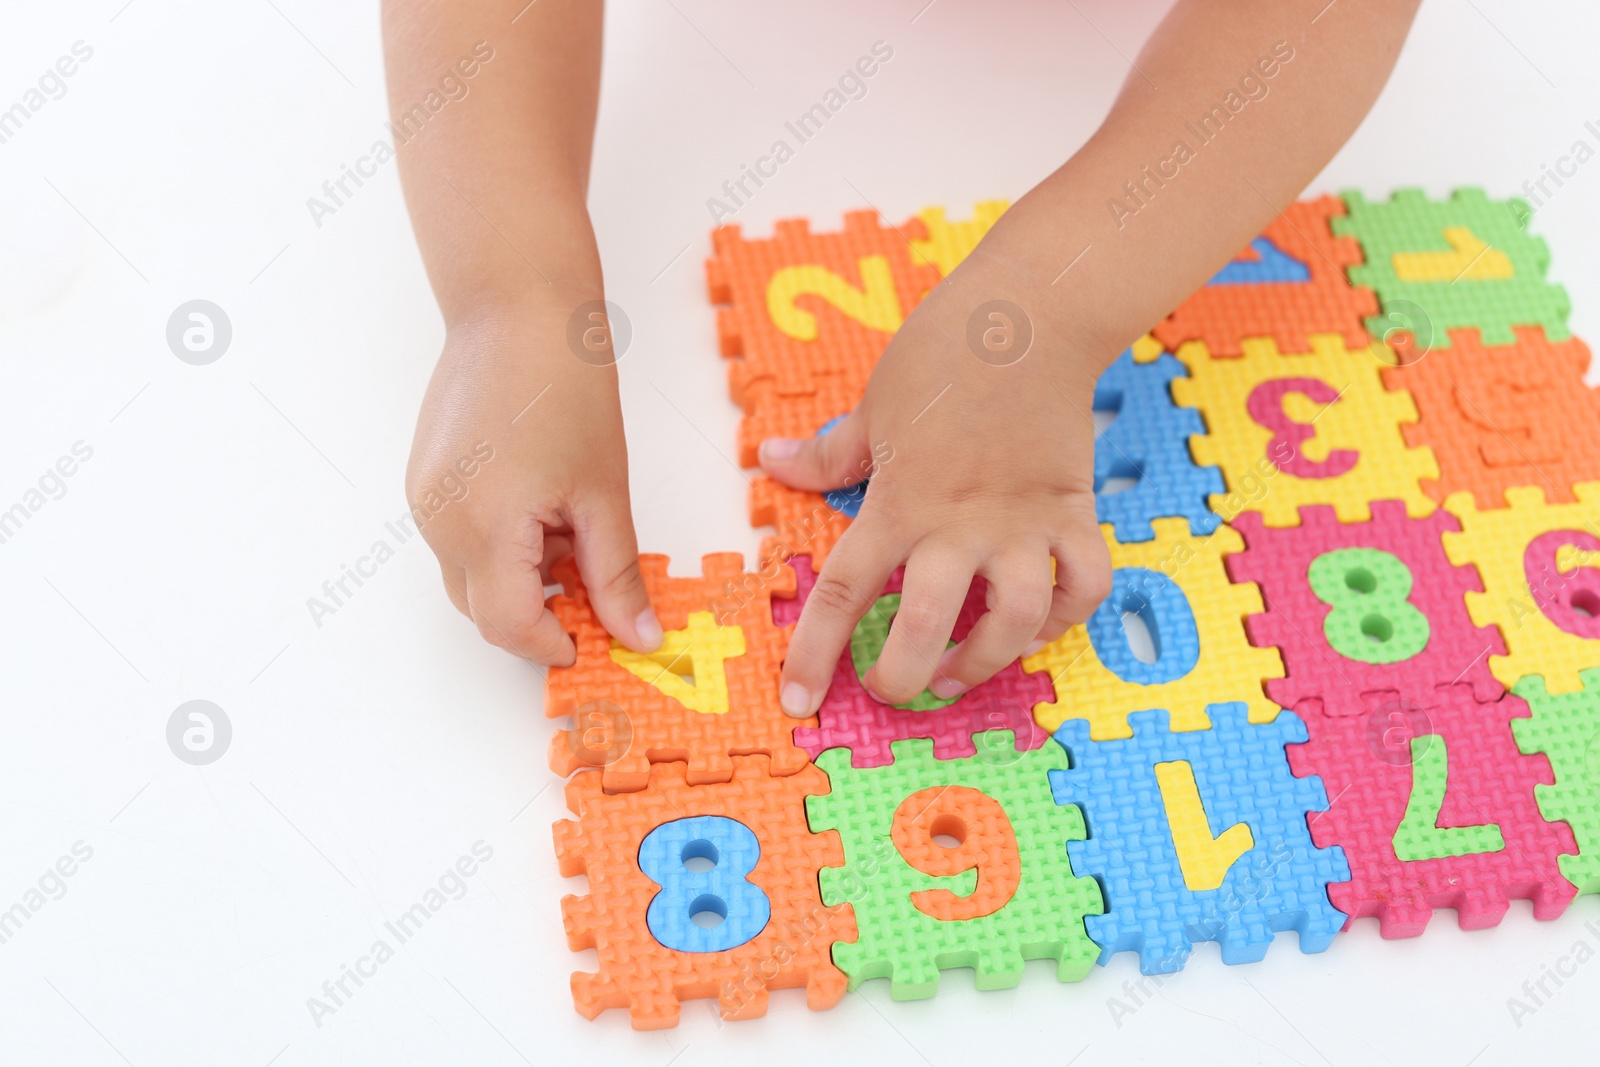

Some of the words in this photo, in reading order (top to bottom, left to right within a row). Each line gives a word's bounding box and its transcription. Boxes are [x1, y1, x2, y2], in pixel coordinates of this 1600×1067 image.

[766, 255, 902, 341] 2
[1392, 227, 1516, 282] 1
[1246, 377, 1359, 479] 3
[609, 611, 746, 714] 4
[1086, 567, 1199, 685] 0
[1308, 547, 1430, 664] 8
[1154, 760, 1254, 891] 1
[1392, 734, 1505, 862] 7
[637, 815, 771, 954] 8
